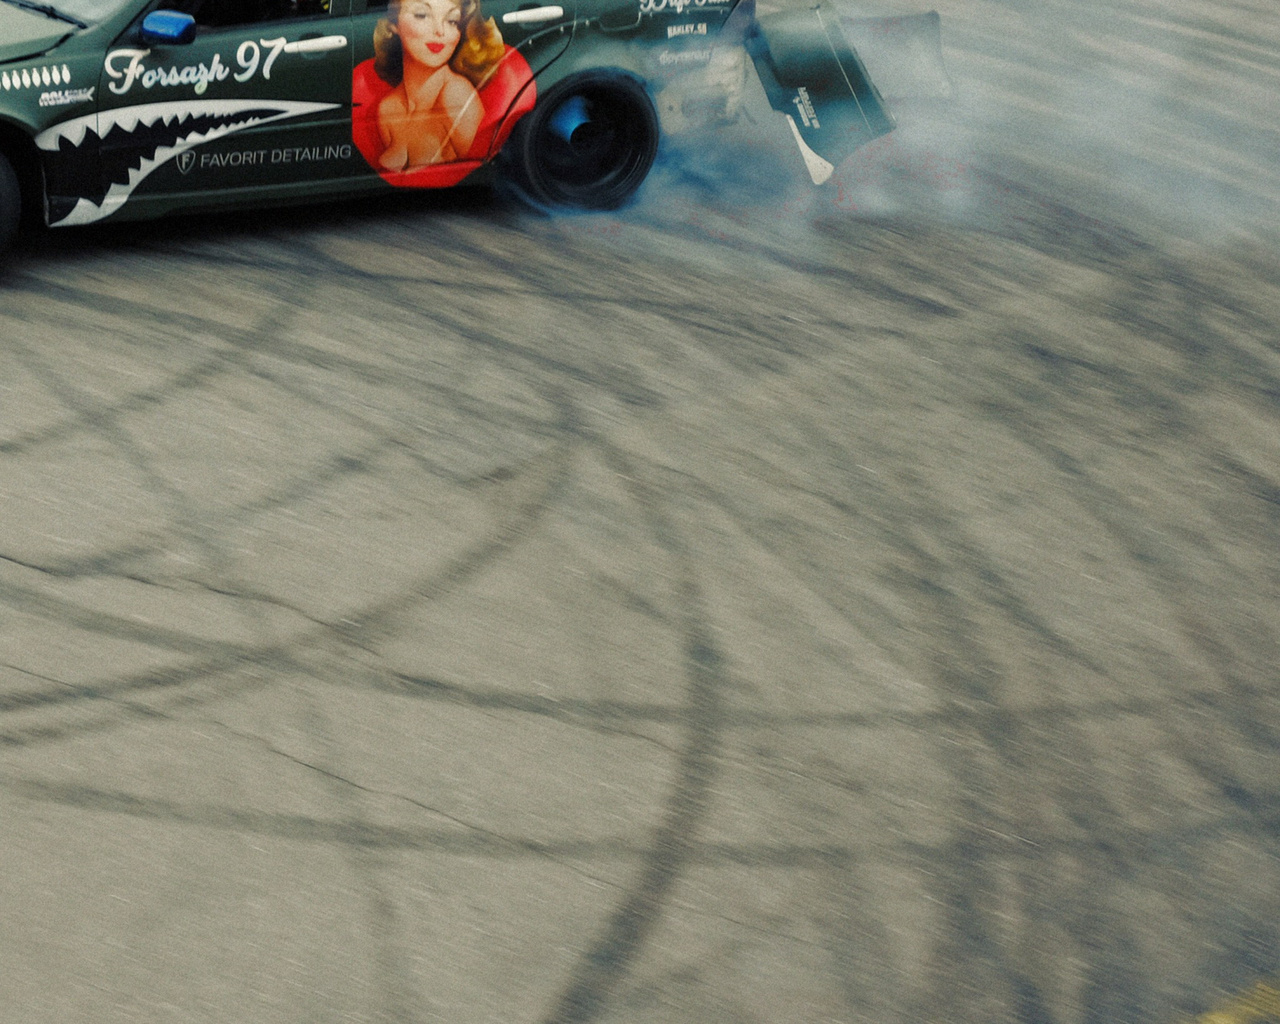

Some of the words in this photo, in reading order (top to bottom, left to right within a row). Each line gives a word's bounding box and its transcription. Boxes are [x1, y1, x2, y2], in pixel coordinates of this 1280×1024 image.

[233, 36, 287, 83] 97
[200, 149, 267, 168] FAVORIT
[271, 144, 352, 164] DETAILING
